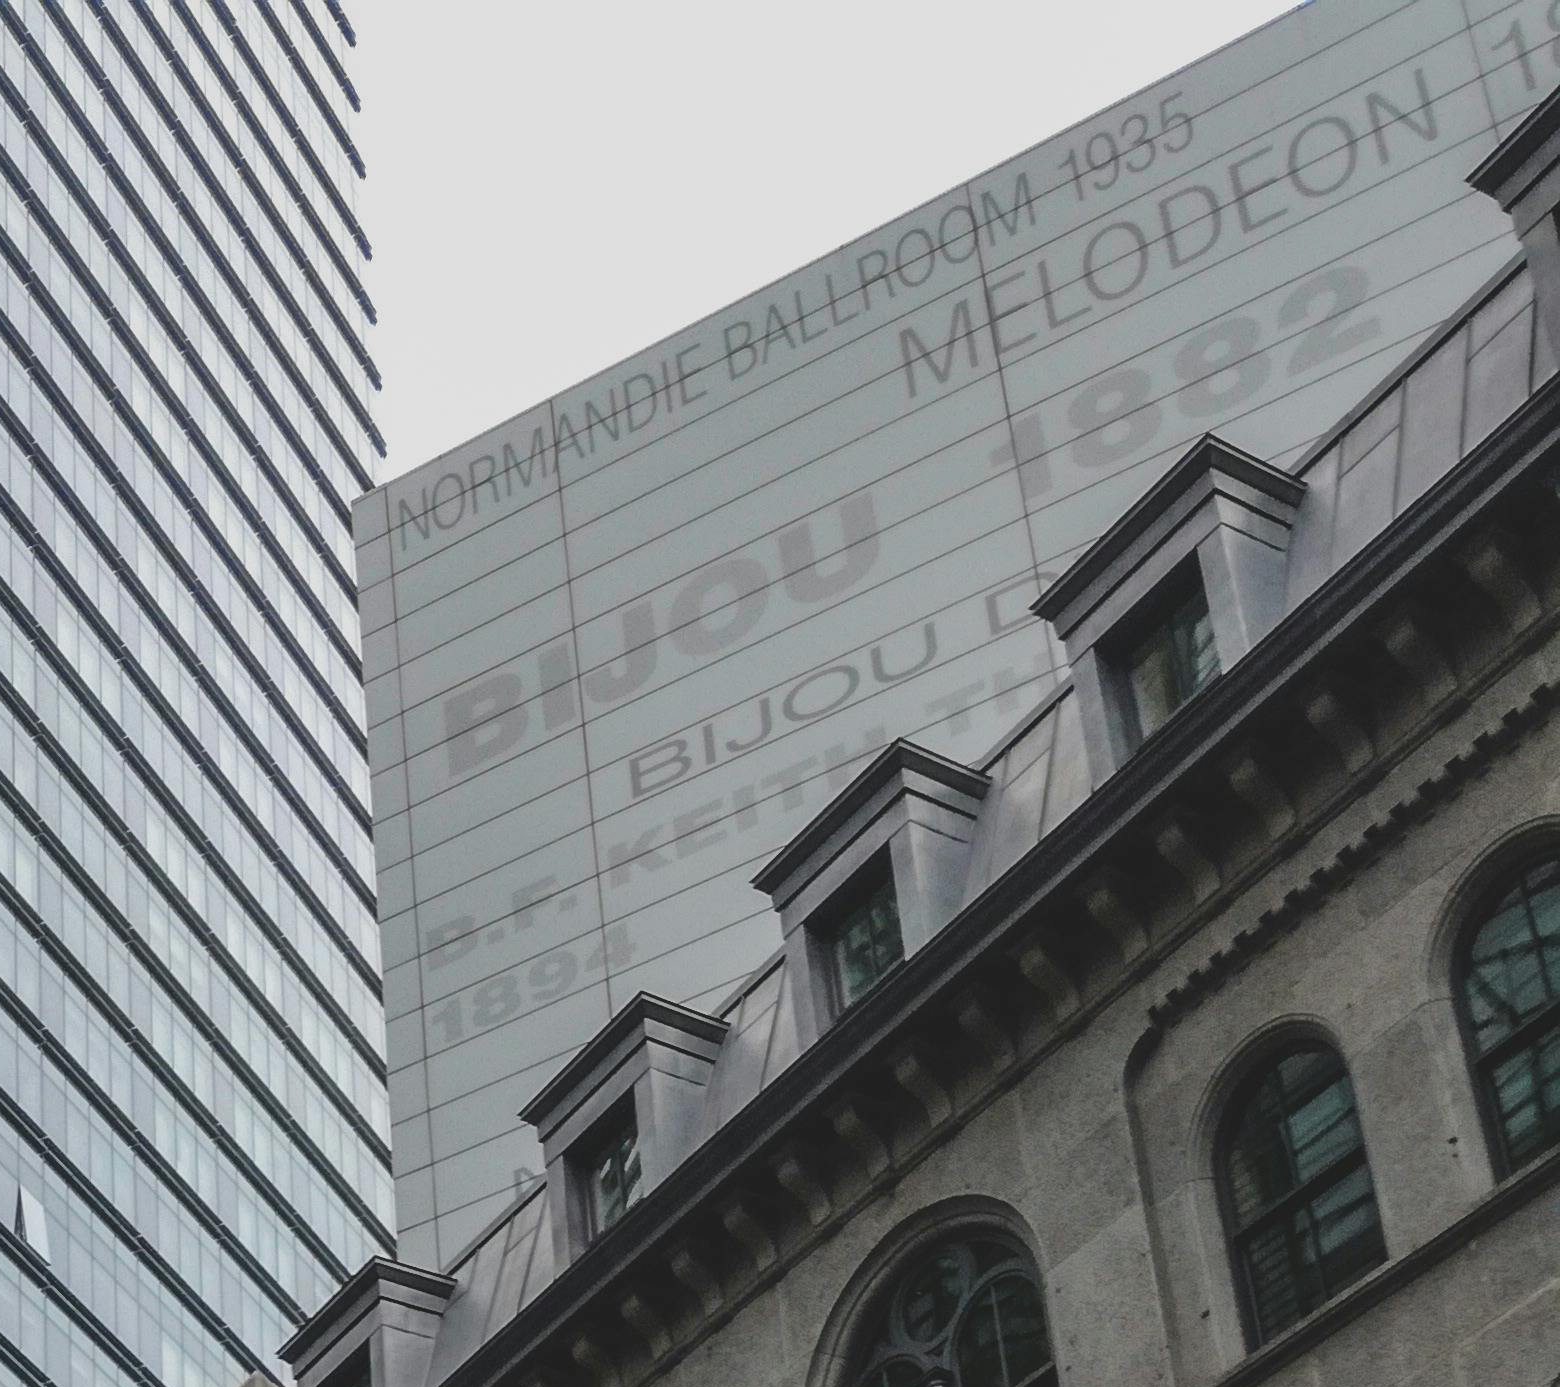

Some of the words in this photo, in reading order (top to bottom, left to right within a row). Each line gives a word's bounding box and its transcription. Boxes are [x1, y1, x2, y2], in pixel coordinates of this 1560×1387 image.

[397, 343, 710, 551] NORMANDIE
[723, 173, 1038, 382] BALLROOM
[1059, 91, 1195, 203] 1935
[898, 67, 1440, 400] MELODEON
[439, 491, 882, 779] BIJOU
[988, 265, 1383, 502] 1882
[627, 620, 938, 800] BIJOU
[430, 919, 640, 1044] 1894
